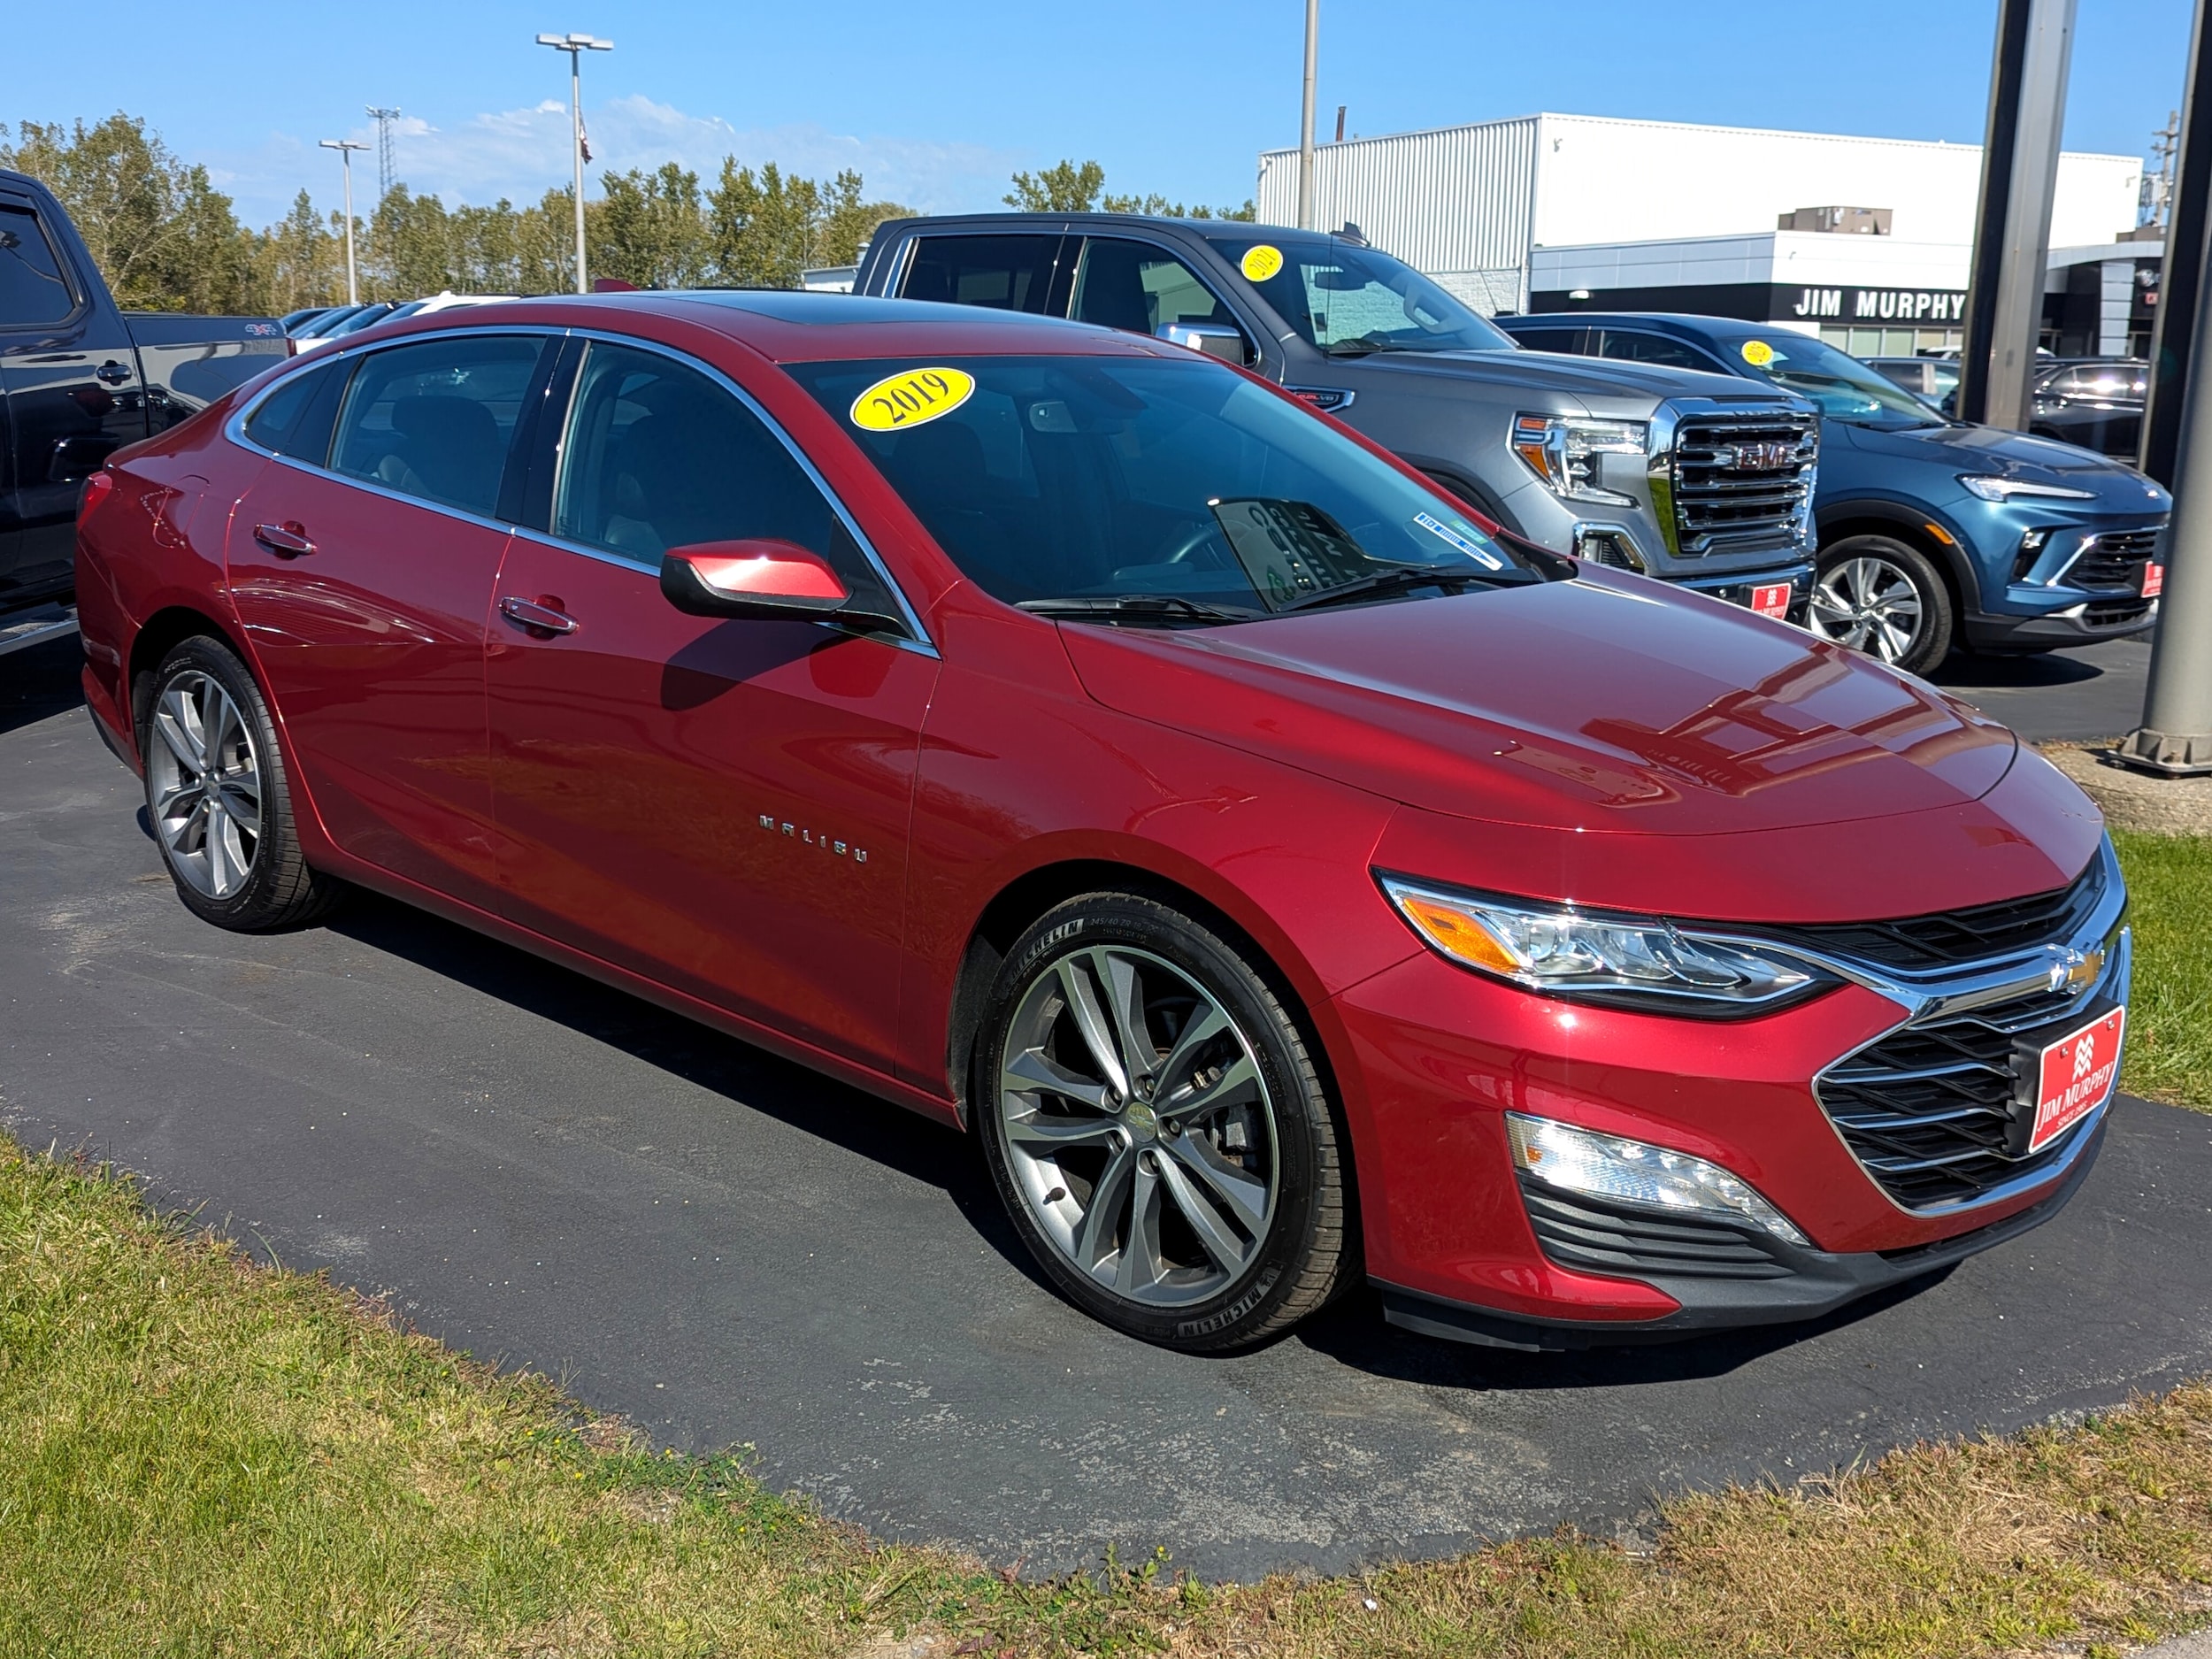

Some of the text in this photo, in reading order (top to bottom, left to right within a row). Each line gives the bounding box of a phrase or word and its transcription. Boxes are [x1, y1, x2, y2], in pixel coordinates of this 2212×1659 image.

[1248, 249, 1276, 277] 2021
[1793, 288, 1966, 320] JIM MURPHY
[872, 373, 949, 424] 2019
[1737, 443, 1796, 470] GMC
[758, 814, 868, 864] MALIBU
[1011, 919, 1080, 979] MICHELIN
[2037, 1060, 2115, 1133] JIM MURPHY
[1183, 1286, 1263, 1337] MICHELIN
